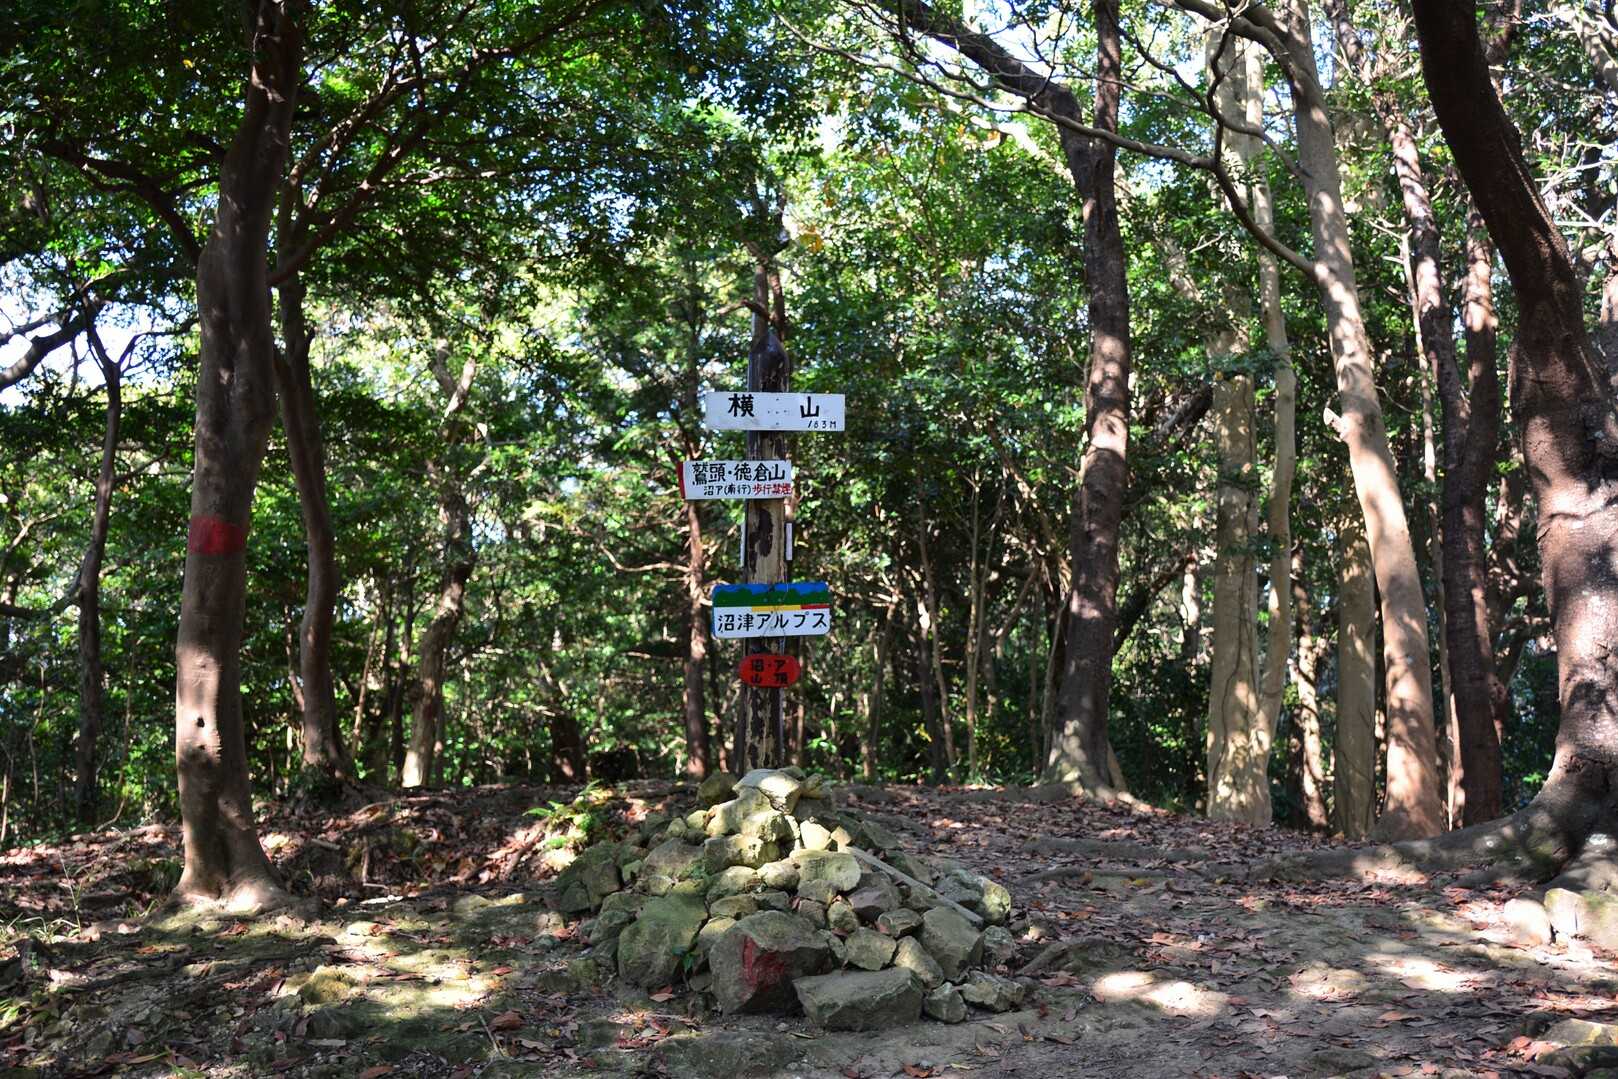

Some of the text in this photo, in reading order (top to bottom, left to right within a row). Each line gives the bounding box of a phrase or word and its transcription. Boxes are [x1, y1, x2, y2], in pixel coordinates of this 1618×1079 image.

[718, 611, 827, 632] 沼津アルプス
